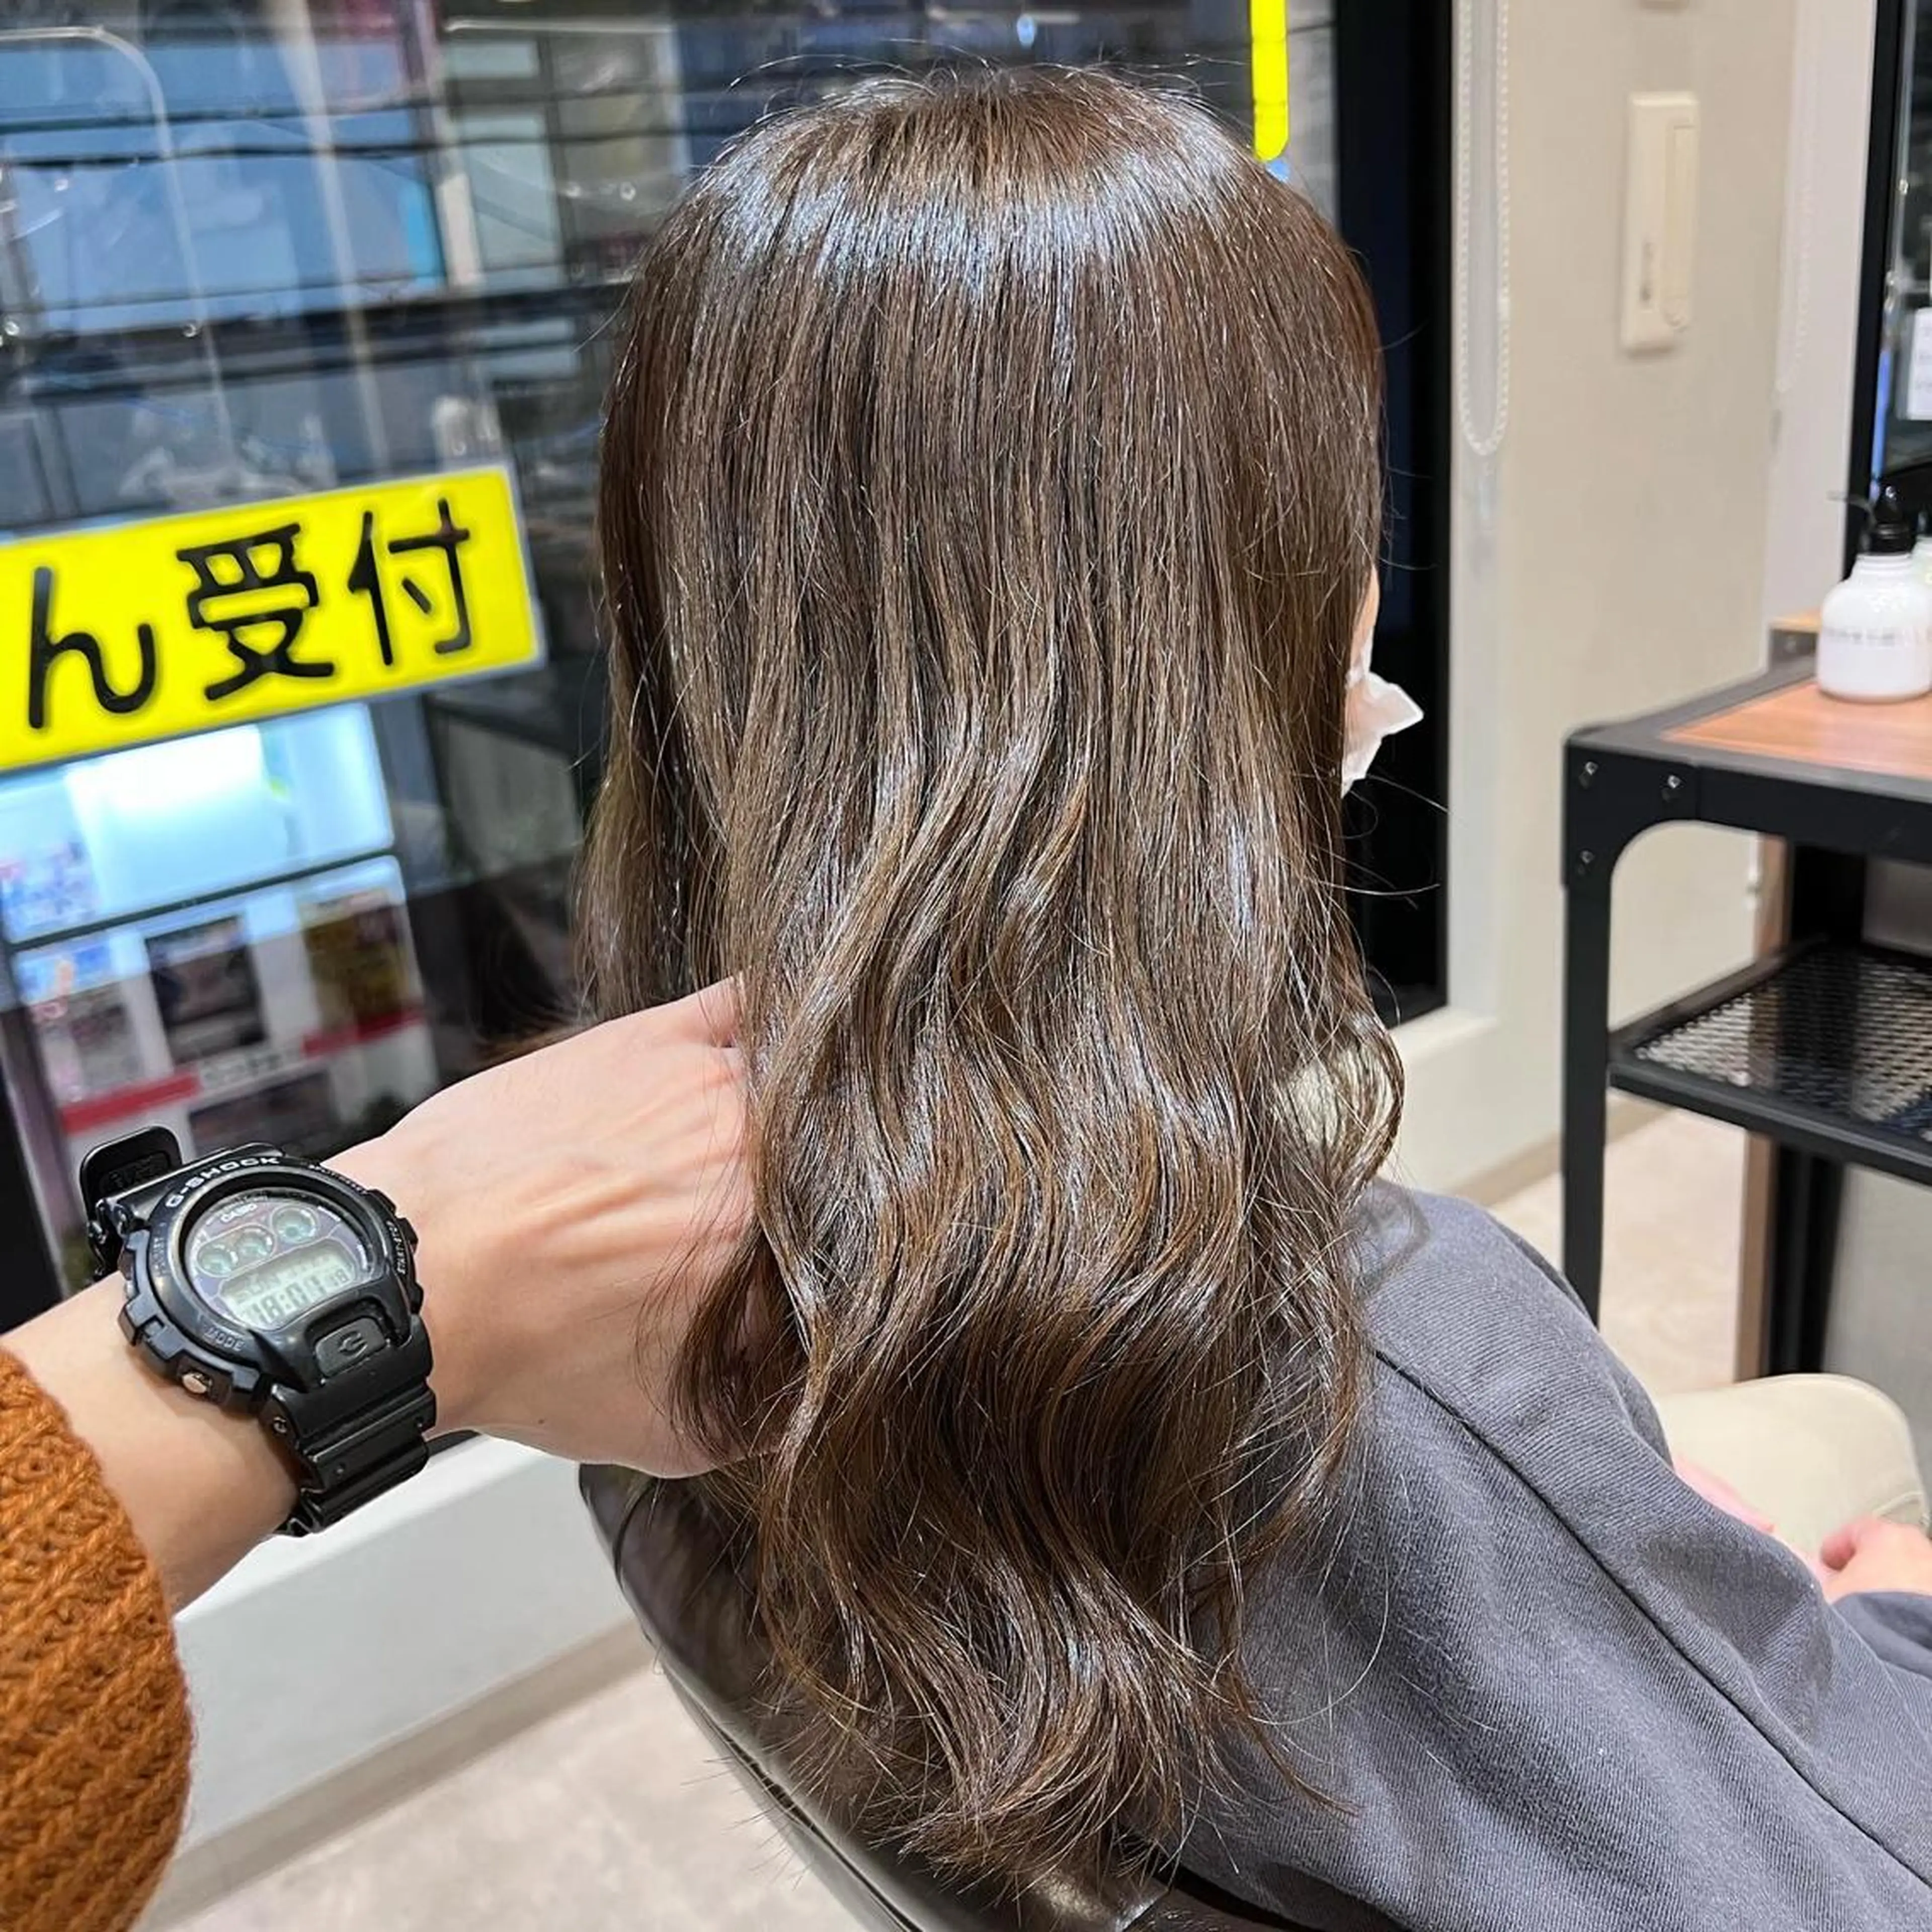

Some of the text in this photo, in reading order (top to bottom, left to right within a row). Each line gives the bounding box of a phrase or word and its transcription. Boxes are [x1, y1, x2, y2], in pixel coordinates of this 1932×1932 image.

[28, 498, 471, 729] ん受付
[165, 1157, 280, 1207] G-SHOCK
